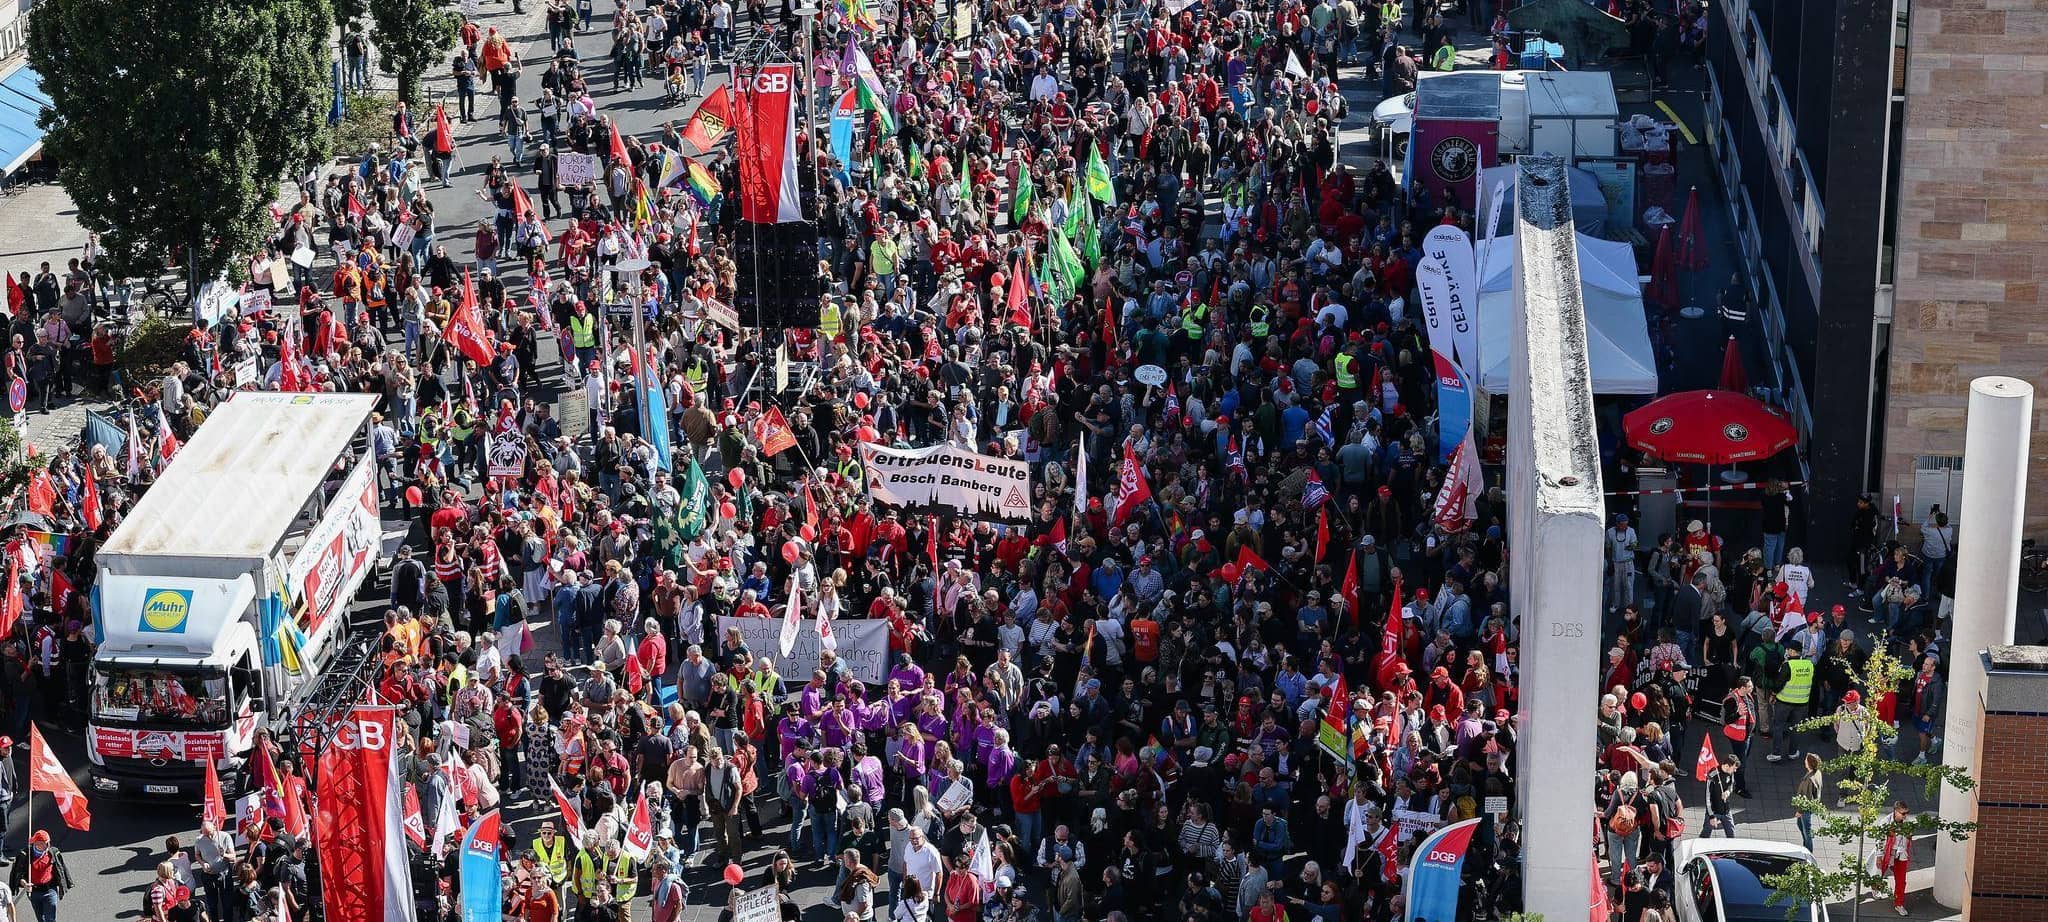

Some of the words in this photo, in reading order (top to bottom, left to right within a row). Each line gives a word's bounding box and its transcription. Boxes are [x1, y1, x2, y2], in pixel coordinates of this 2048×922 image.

[567, 165, 586, 173] FOR
[454, 322, 470, 337] Die
[864, 449, 1027, 480] VertrauensLeute
[890, 473, 935, 484] Bosch
[941, 475, 1002, 497] Bamberg
[148, 601, 184, 613] Muhr
[1551, 622, 1583, 638] DES
[105, 741, 123, 749] retter
[473, 839, 493, 852] DGB
[1430, 850, 1456, 863] DGB
[737, 894, 773, 914] PFLEGE
